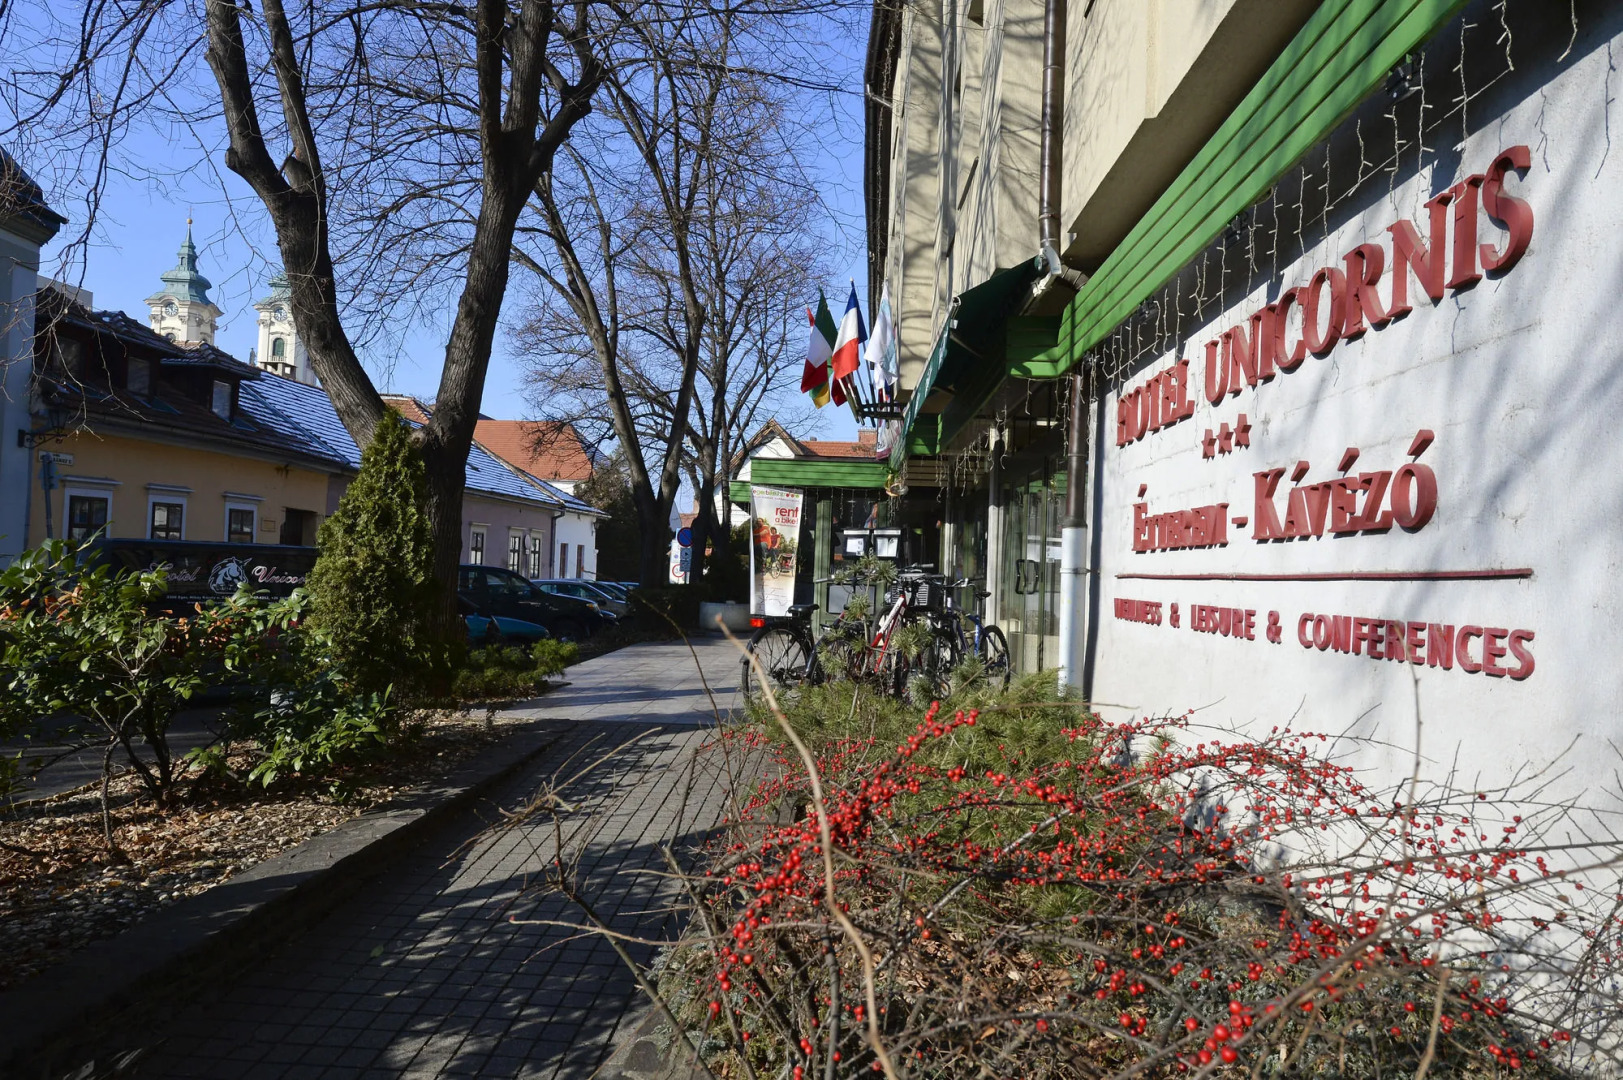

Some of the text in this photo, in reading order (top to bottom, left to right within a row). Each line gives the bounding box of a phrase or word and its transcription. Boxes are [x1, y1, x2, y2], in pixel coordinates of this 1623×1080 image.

[1116, 145, 1535, 447] HOTEL UNICORNIS
[775, 506, 800, 518] rent
[1251, 429, 1438, 541] KÁVÉZÓ
[1190, 604, 1257, 641] LEISURE
[1266, 610, 1283, 644] &
[1297, 612, 1536, 680] CONFERENCES
